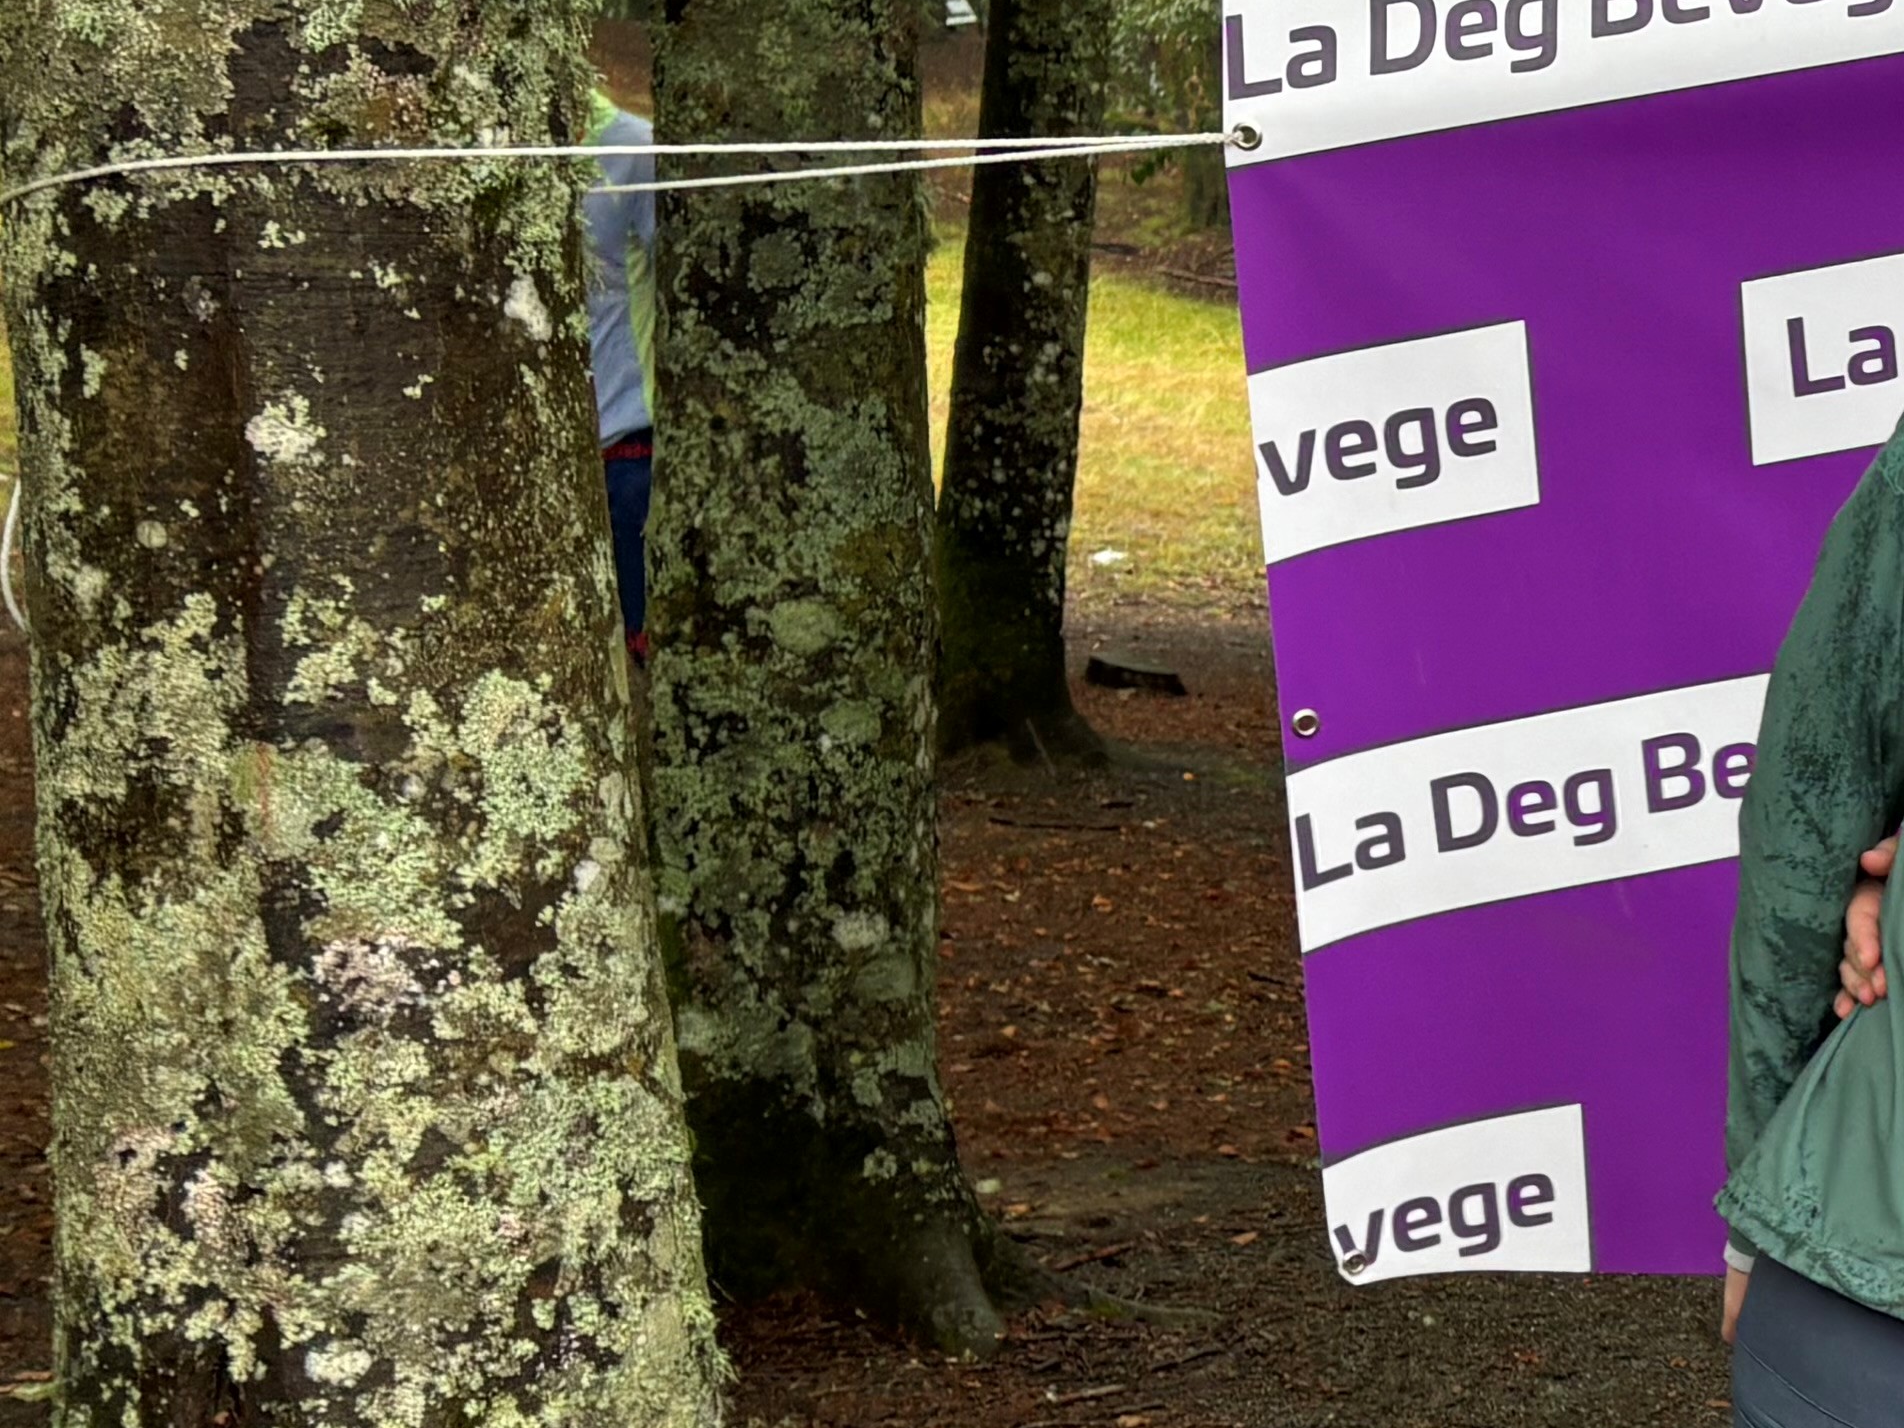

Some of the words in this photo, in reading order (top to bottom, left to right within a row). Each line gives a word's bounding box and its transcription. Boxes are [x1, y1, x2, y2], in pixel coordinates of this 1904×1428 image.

[1226, 15, 1336, 100] La
[1787, 317, 1898, 397] La
[1296, 812, 1405, 891] La
[1431, 769, 1616, 852] Deg
